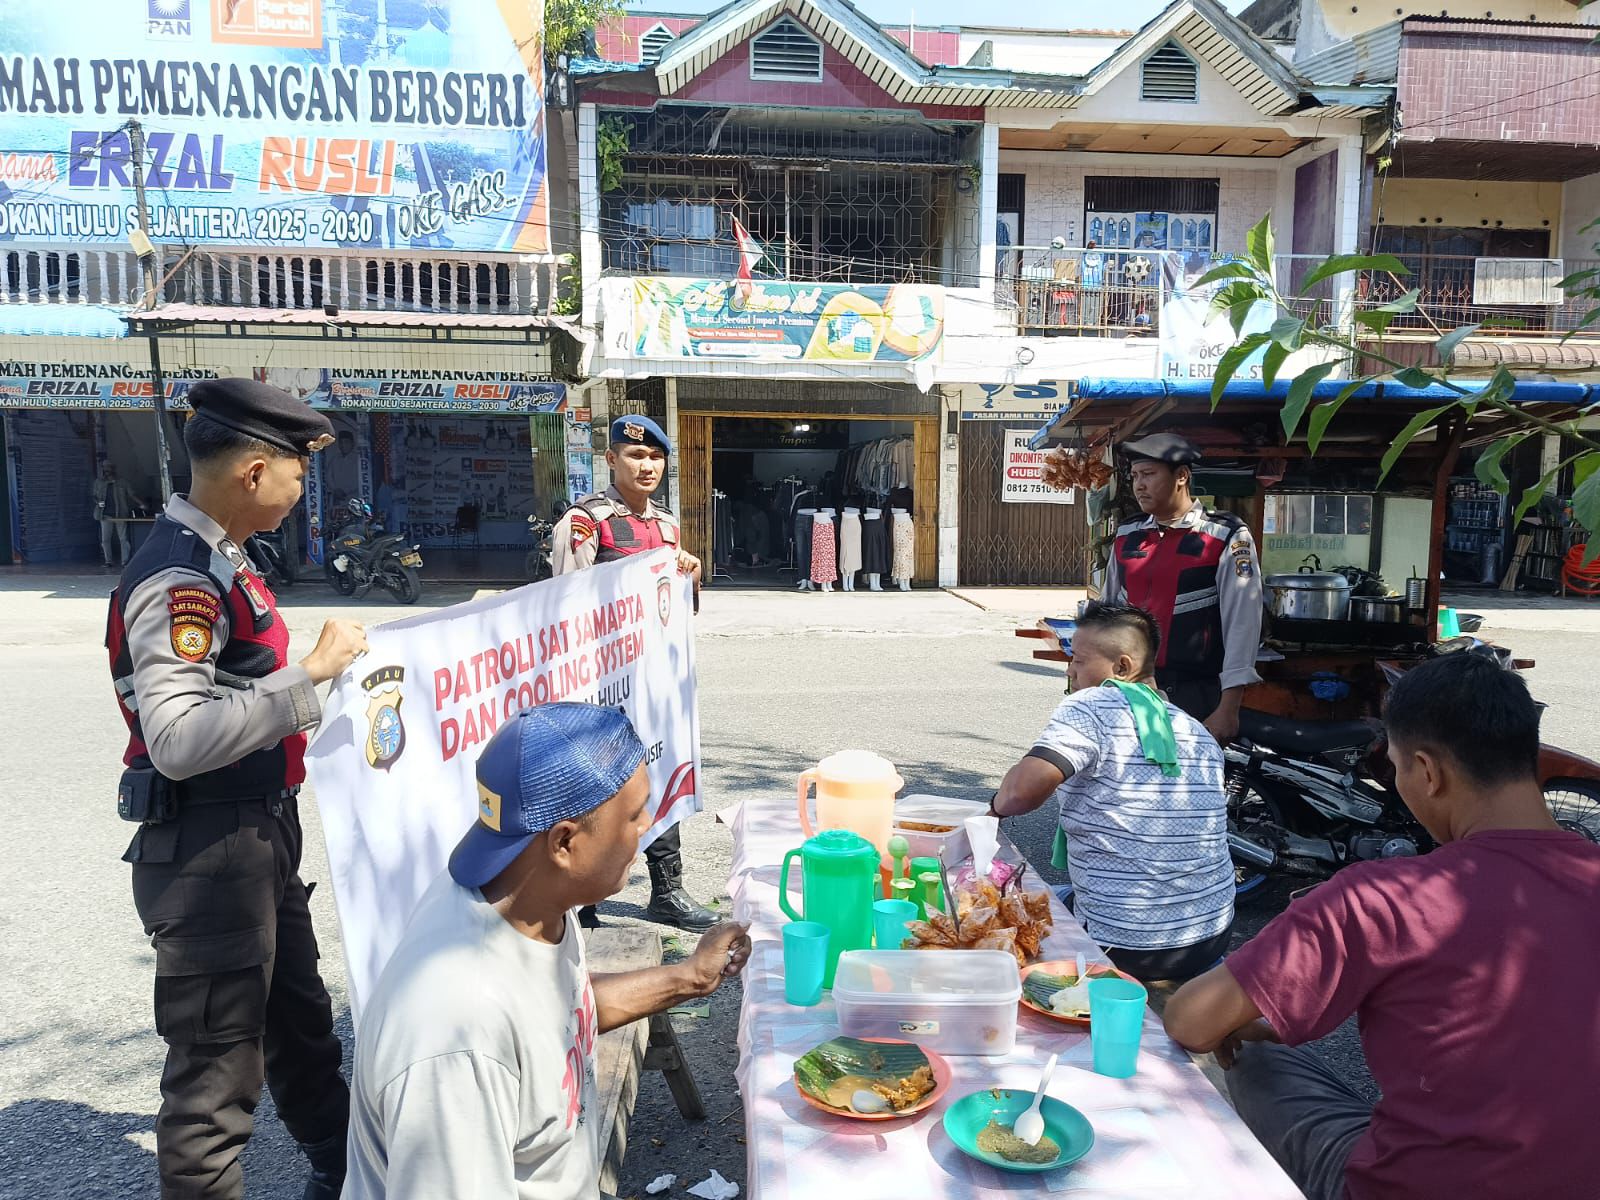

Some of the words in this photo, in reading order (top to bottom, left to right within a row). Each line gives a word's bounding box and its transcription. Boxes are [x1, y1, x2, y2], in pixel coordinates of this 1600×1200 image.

[148, 20, 191, 36] PAN
[258, 15, 311, 32] Buruh
[90, 59, 360, 122] PEMENANGAN
[370, 70, 526, 127] BERSERI
[69, 131, 235, 190] ERZAL
[259, 137, 397, 195] RUSLI
[60, 204, 121, 237] HULU
[255, 208, 305, 240] 2025
[322, 210, 373, 242] 2030
[399, 190, 442, 239] OKE
[723, 314, 750, 324] Second
[753, 315, 776, 327] Impor
[779, 315, 814, 326] Premium
[391, 369, 497, 381] PEMENANGAN
[1168, 363, 1183, 377] H.
[27, 380, 101, 396] ERIZAL
[111, 382, 174, 396] RUSI
[379, 382, 446, 398] ERIZAL
[454, 384, 510, 399] RUSLI
[22, 399, 49, 408] HULU
[51, 400, 107, 409] SEJAHTERA
[109, 400, 131, 409] 2025
[341, 399, 372, 409] ROKAN
[374, 400, 398, 409] HULU
[399, 401, 450, 410] SEJAHTERA
[452, 402, 472, 410] 2025
[479, 402, 500, 411] 2030
[509, 396, 528, 410] OKE
[1007, 484, 1028, 493] 0812
[173, 602, 186, 611] SAT
[186, 602, 217, 619] SAMAPTA
[434, 633, 535, 711] PATROLI
[539, 620, 569, 664] SAT
[574, 593, 645, 648] SAMAPTA
[366, 669, 400, 690] RIAU
[440, 697, 497, 762] DAN
[503, 654, 591, 721] COOLING
[594, 629, 644, 680] SYSTEM
[598, 674, 630, 707] HULU
